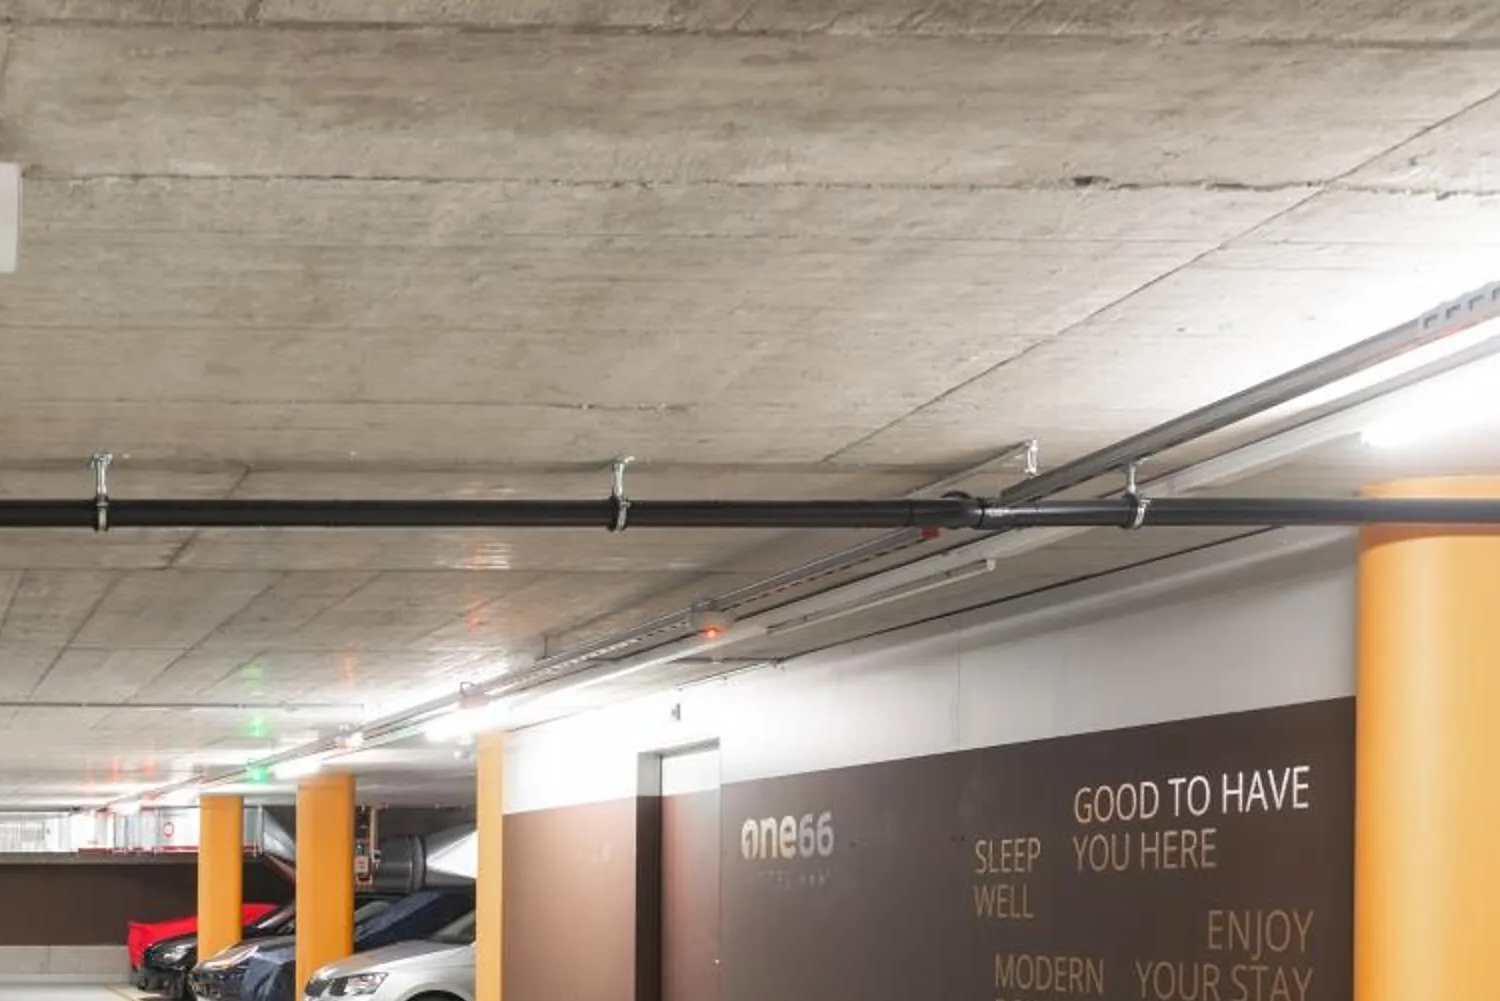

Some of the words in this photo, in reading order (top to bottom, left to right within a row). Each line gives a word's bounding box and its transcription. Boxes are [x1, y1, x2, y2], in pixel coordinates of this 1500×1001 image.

[1074, 781, 1160, 824] GOOD
[1167, 775, 1211, 817] TO
[1221, 765, 1311, 814] HAVE
[975, 837, 1042, 874] SLEEP
[1072, 832, 1131, 873] YOU
[1140, 827, 1217, 870] HERE
[973, 884, 1035, 919] WELL
[1207, 909, 1314, 961] ENJOY
[994, 953, 1105, 994] MODERN
